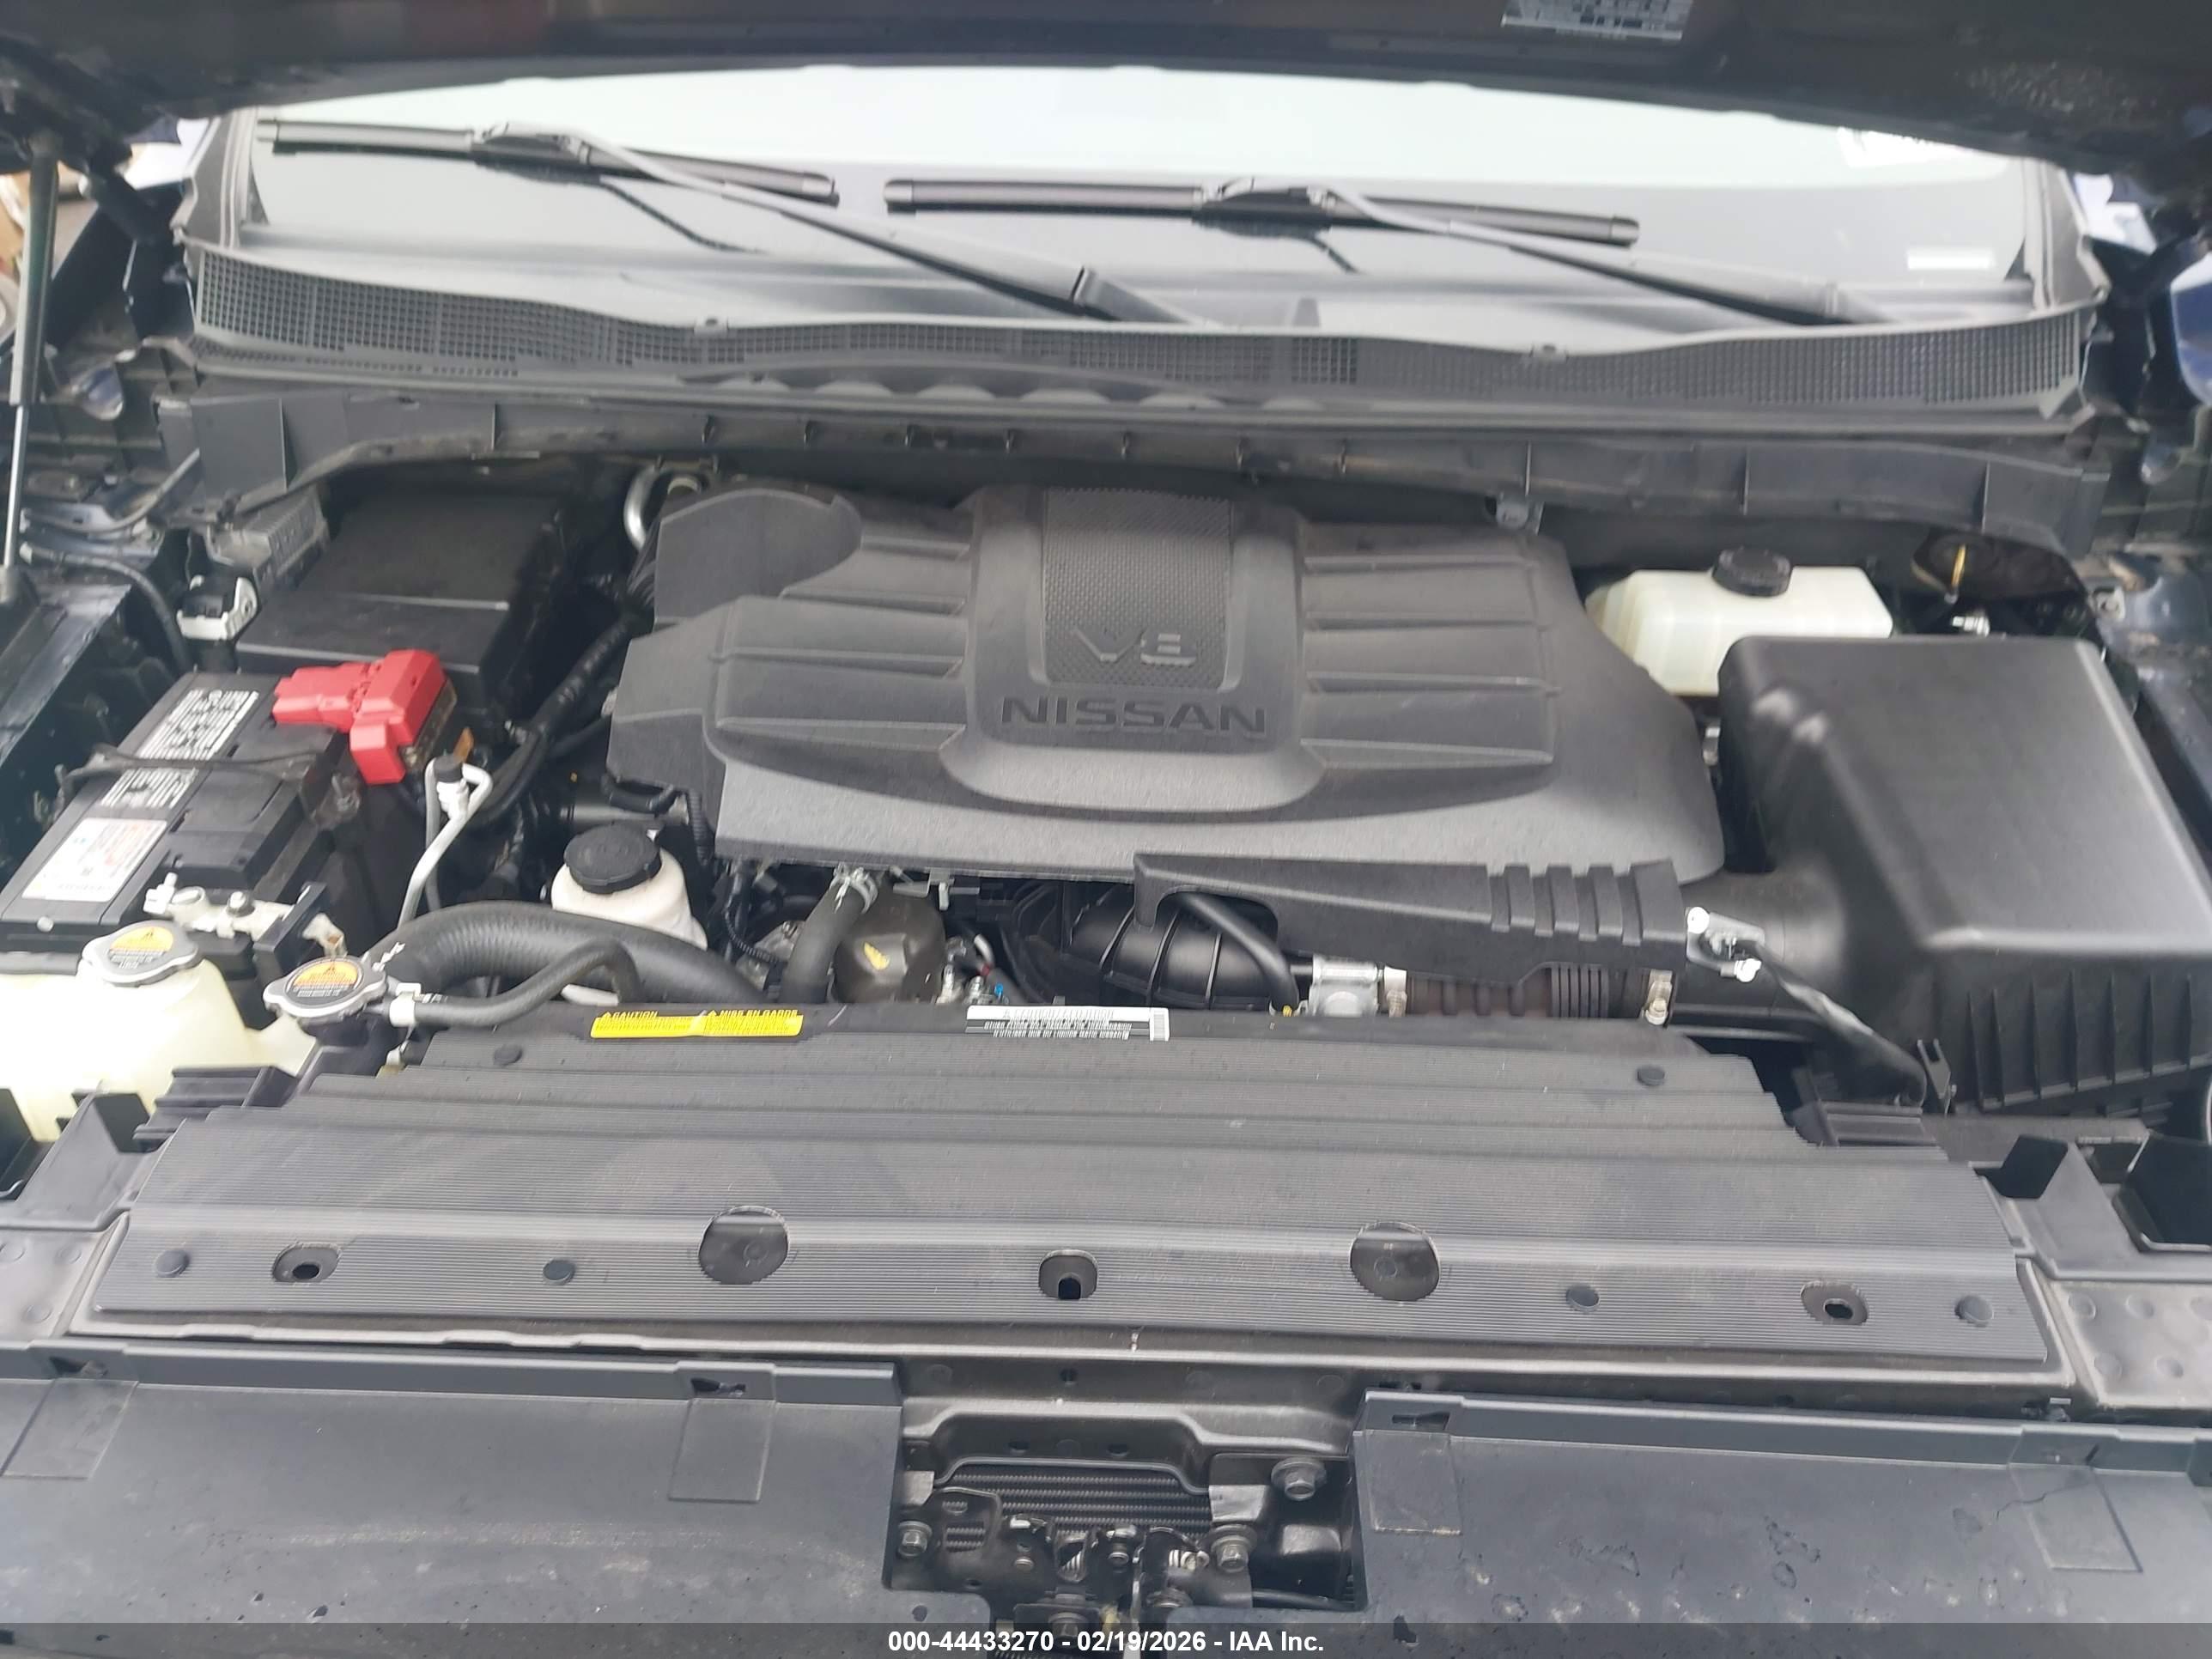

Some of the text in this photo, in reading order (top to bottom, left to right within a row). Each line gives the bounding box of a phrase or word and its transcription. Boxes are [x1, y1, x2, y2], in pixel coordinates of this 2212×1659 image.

[1071, 627, 1197, 666] V8
[1001, 696, 1266, 733] NISSAN
[611, 1010, 659, 1019] CAUTION
